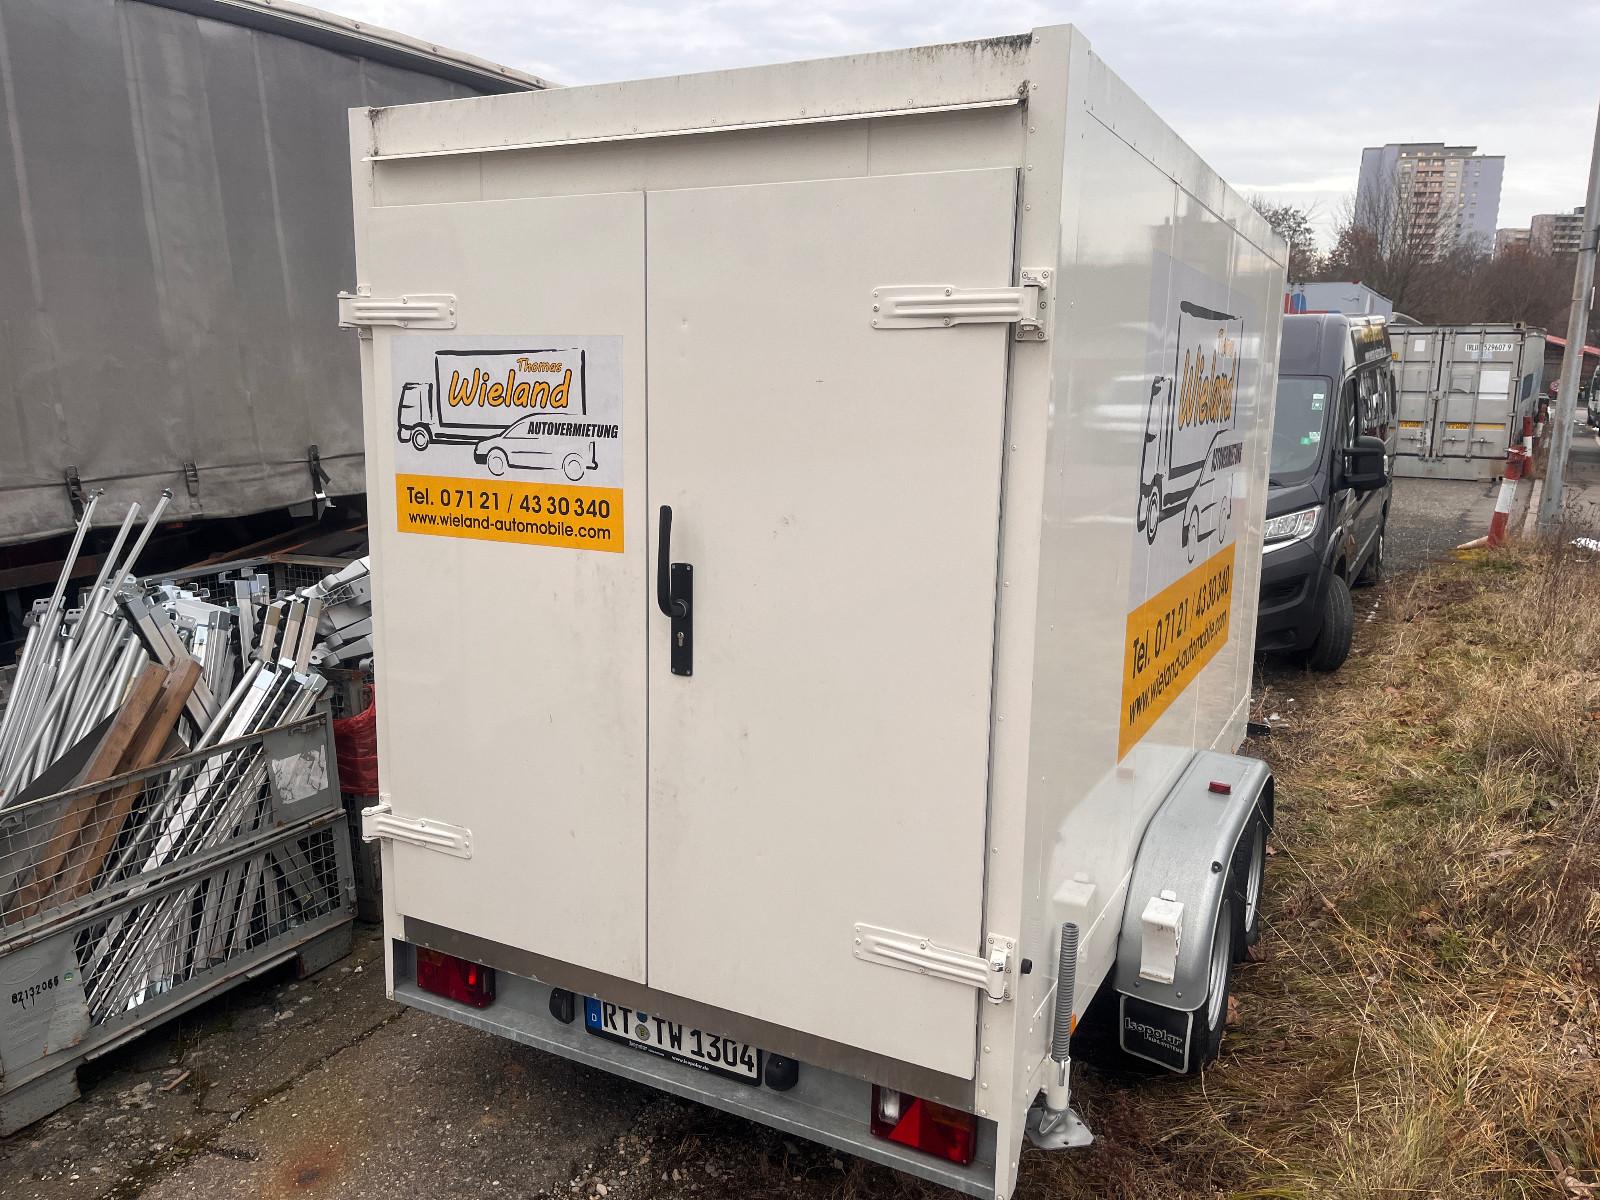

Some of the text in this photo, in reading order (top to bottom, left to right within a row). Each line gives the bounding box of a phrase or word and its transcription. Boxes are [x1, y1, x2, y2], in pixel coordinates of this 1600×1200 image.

[516, 357, 563, 373] Thomas
[448, 367, 573, 409] Wieland
[1178, 344, 1237, 431] Wieland
[527, 421, 619, 439] AUTOVERMIETUNG
[406, 486, 434, 506] Tel.
[409, 512, 611, 540] www.wieland-automobile.com
[1129, 609, 1227, 727] www.wieland-automobile.com
[1132, 629, 1150, 680] Tel.
[591, 1013, 598, 1022] D
[1125, 1017, 1182, 1045] Isopolar
[603, 1001, 755, 1073] RT TW 1304
